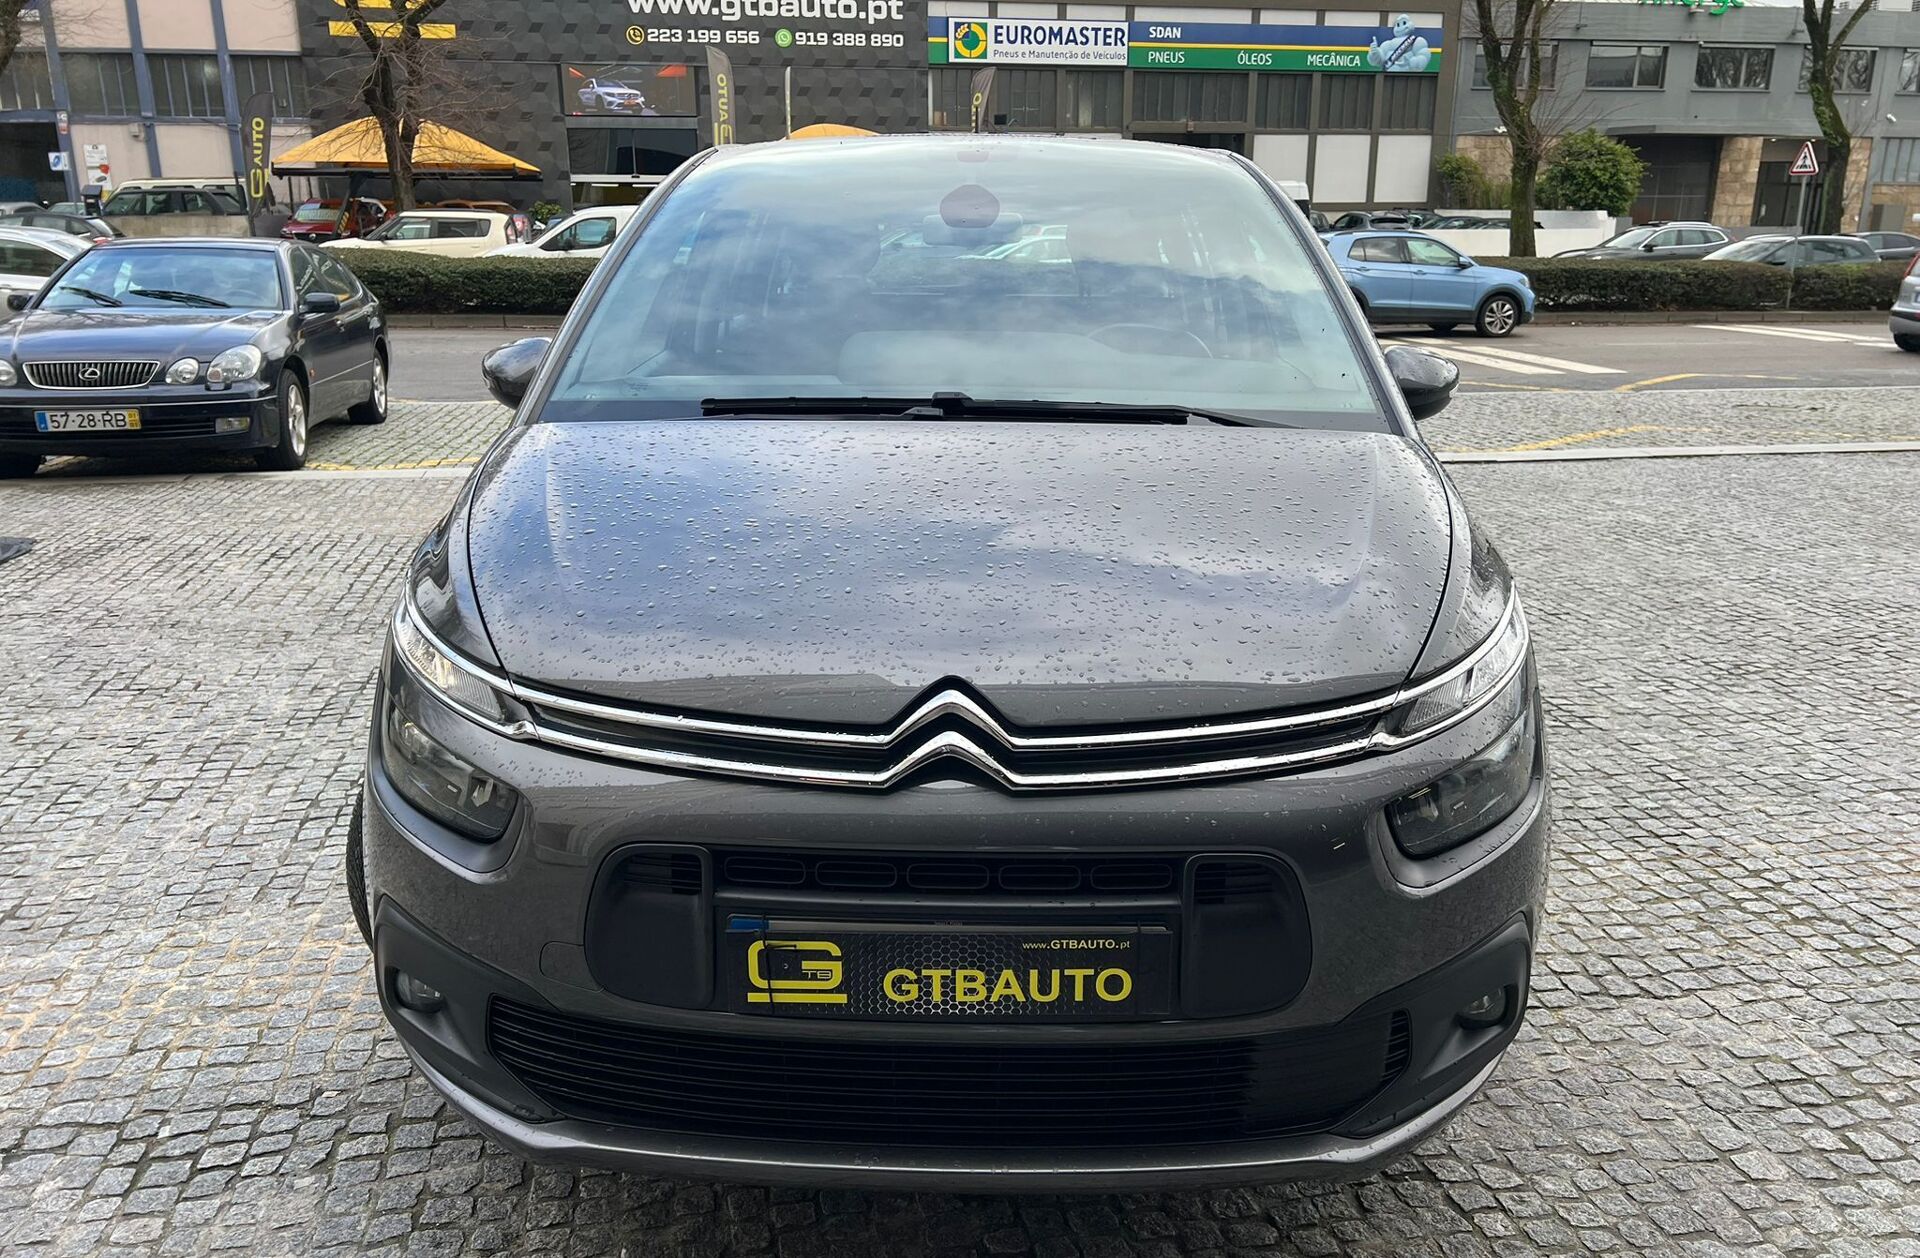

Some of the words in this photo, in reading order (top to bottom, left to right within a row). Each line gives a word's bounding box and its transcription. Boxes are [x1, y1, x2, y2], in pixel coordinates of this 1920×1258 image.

[647, 28, 683, 44] 223
[687, 29, 721, 44] 199
[725, 30, 760, 44] 656
[795, 31, 828, 46] 919
[832, 32, 866, 47] 388
[870, 33, 904, 48] 890
[993, 25, 1126, 47] EUROMASTER
[1149, 26, 1181, 39] SDAN
[993, 50, 1019, 59] Pneus
[1028, 50, 1078, 60] Manutenção
[1080, 51, 1091, 60] de
[1092, 51, 1126, 61] Veículos
[1148, 51, 1185, 64] PNEUS
[1237, 50, 1272, 65] ÓLEOS
[1307, 52, 1361, 67] MECÂNICA
[1022, 939, 1130, 951] www.GTBAUTO.pt
[882, 967, 1133, 1003] GTBAUTO
